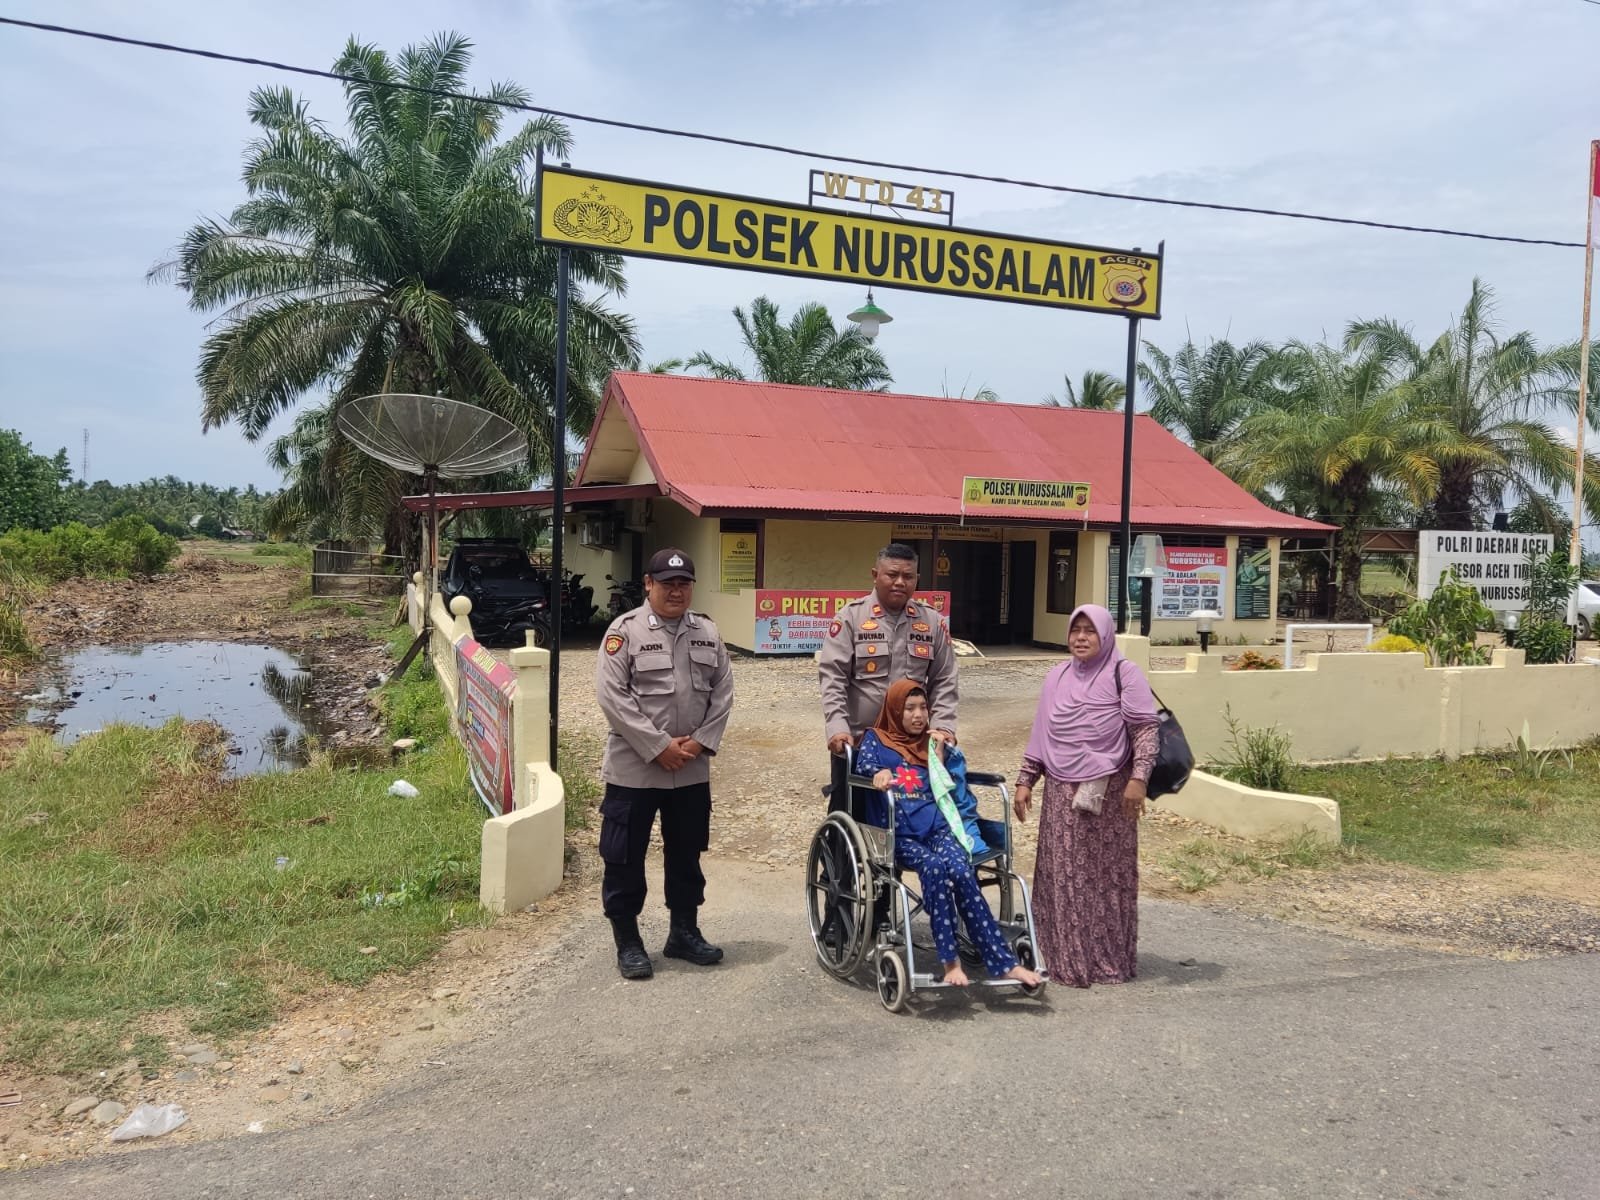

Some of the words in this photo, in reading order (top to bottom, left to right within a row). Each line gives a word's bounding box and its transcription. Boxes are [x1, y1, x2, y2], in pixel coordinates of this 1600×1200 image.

[823, 171, 894, 206] WTD
[906, 186, 943, 212] 43
[643, 193, 819, 268] POLSEK
[833, 224, 1096, 301] NURUSSALAM
[1105, 256, 1147, 268] ACEH
[983, 481, 1016, 496] POLSEK
[1018, 483, 1074, 498] NURUSSALAM
[1437, 536, 1472, 552] POLRI
[1476, 537, 1519, 554] DAERAH
[1522, 538, 1548, 554] ACEH
[1169, 557, 1215, 565] NURUSSALAM
[1486, 563, 1509, 578] ACEH
[1514, 564, 1533, 579] TIM
[1481, 586, 1533, 601] NURUSSAL
[781, 597, 830, 614] PIKET
[691, 640, 715, 649] POLRI
[910, 633, 933, 643] POLRI
[640, 643, 662, 652] ADIN
